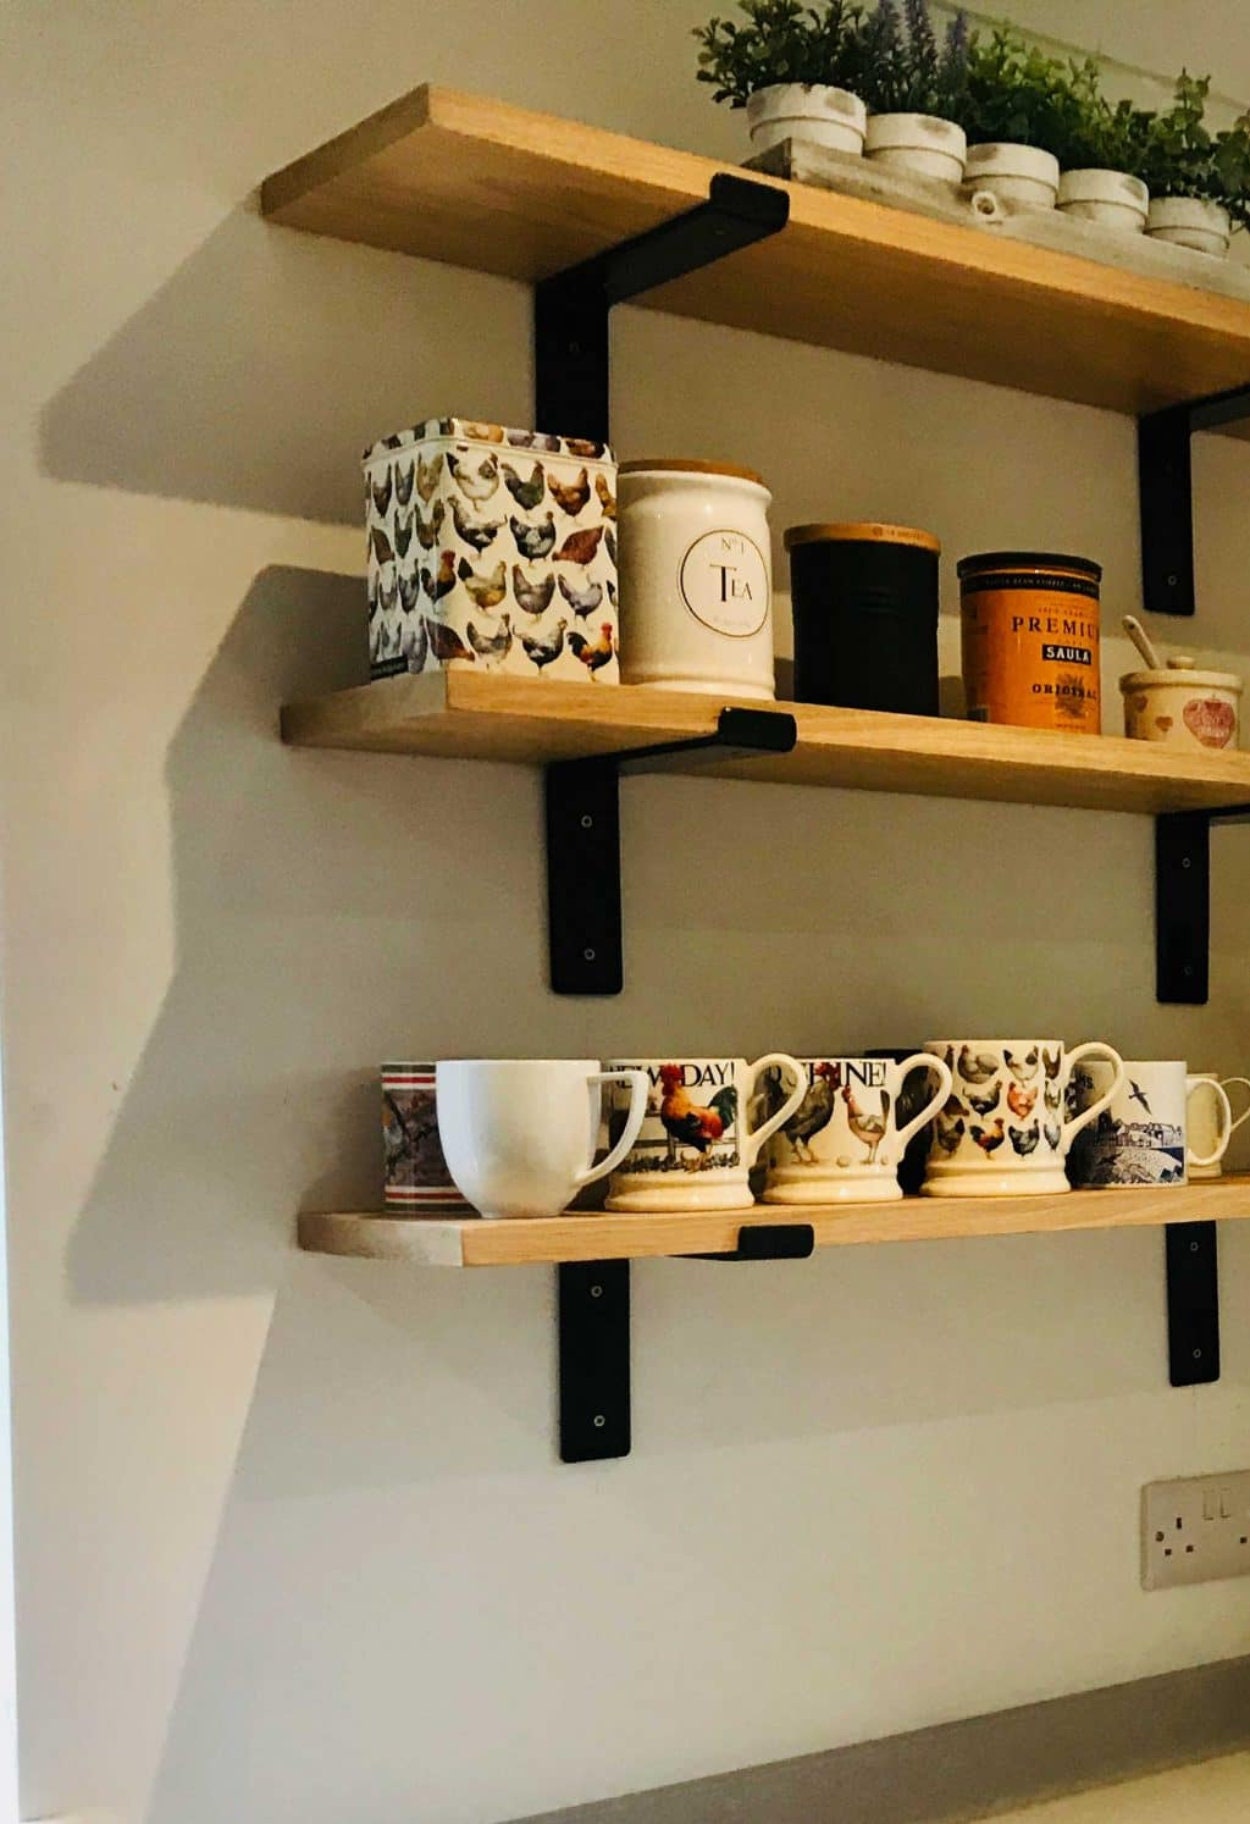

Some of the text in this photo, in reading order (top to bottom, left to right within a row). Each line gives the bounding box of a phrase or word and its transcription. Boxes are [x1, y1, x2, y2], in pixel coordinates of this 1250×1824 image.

[709, 563, 752, 602] TEA
[1046, 645, 1089, 663] SAULA
[680, 1061, 736, 1088] DAY!
